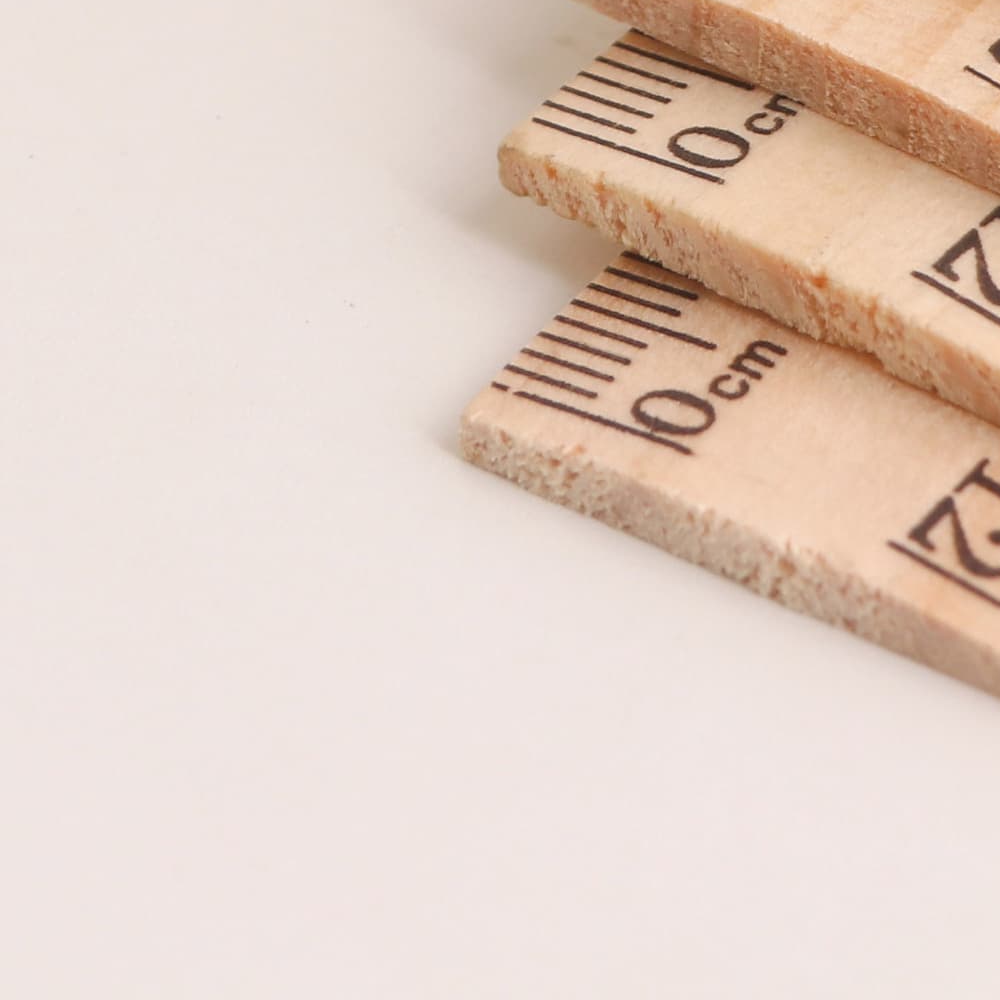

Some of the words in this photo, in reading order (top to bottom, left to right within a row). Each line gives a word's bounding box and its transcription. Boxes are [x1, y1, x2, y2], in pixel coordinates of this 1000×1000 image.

[667, 126, 750, 168] 0
[631, 389, 716, 435] 0
[708, 340, 788, 400] cm
